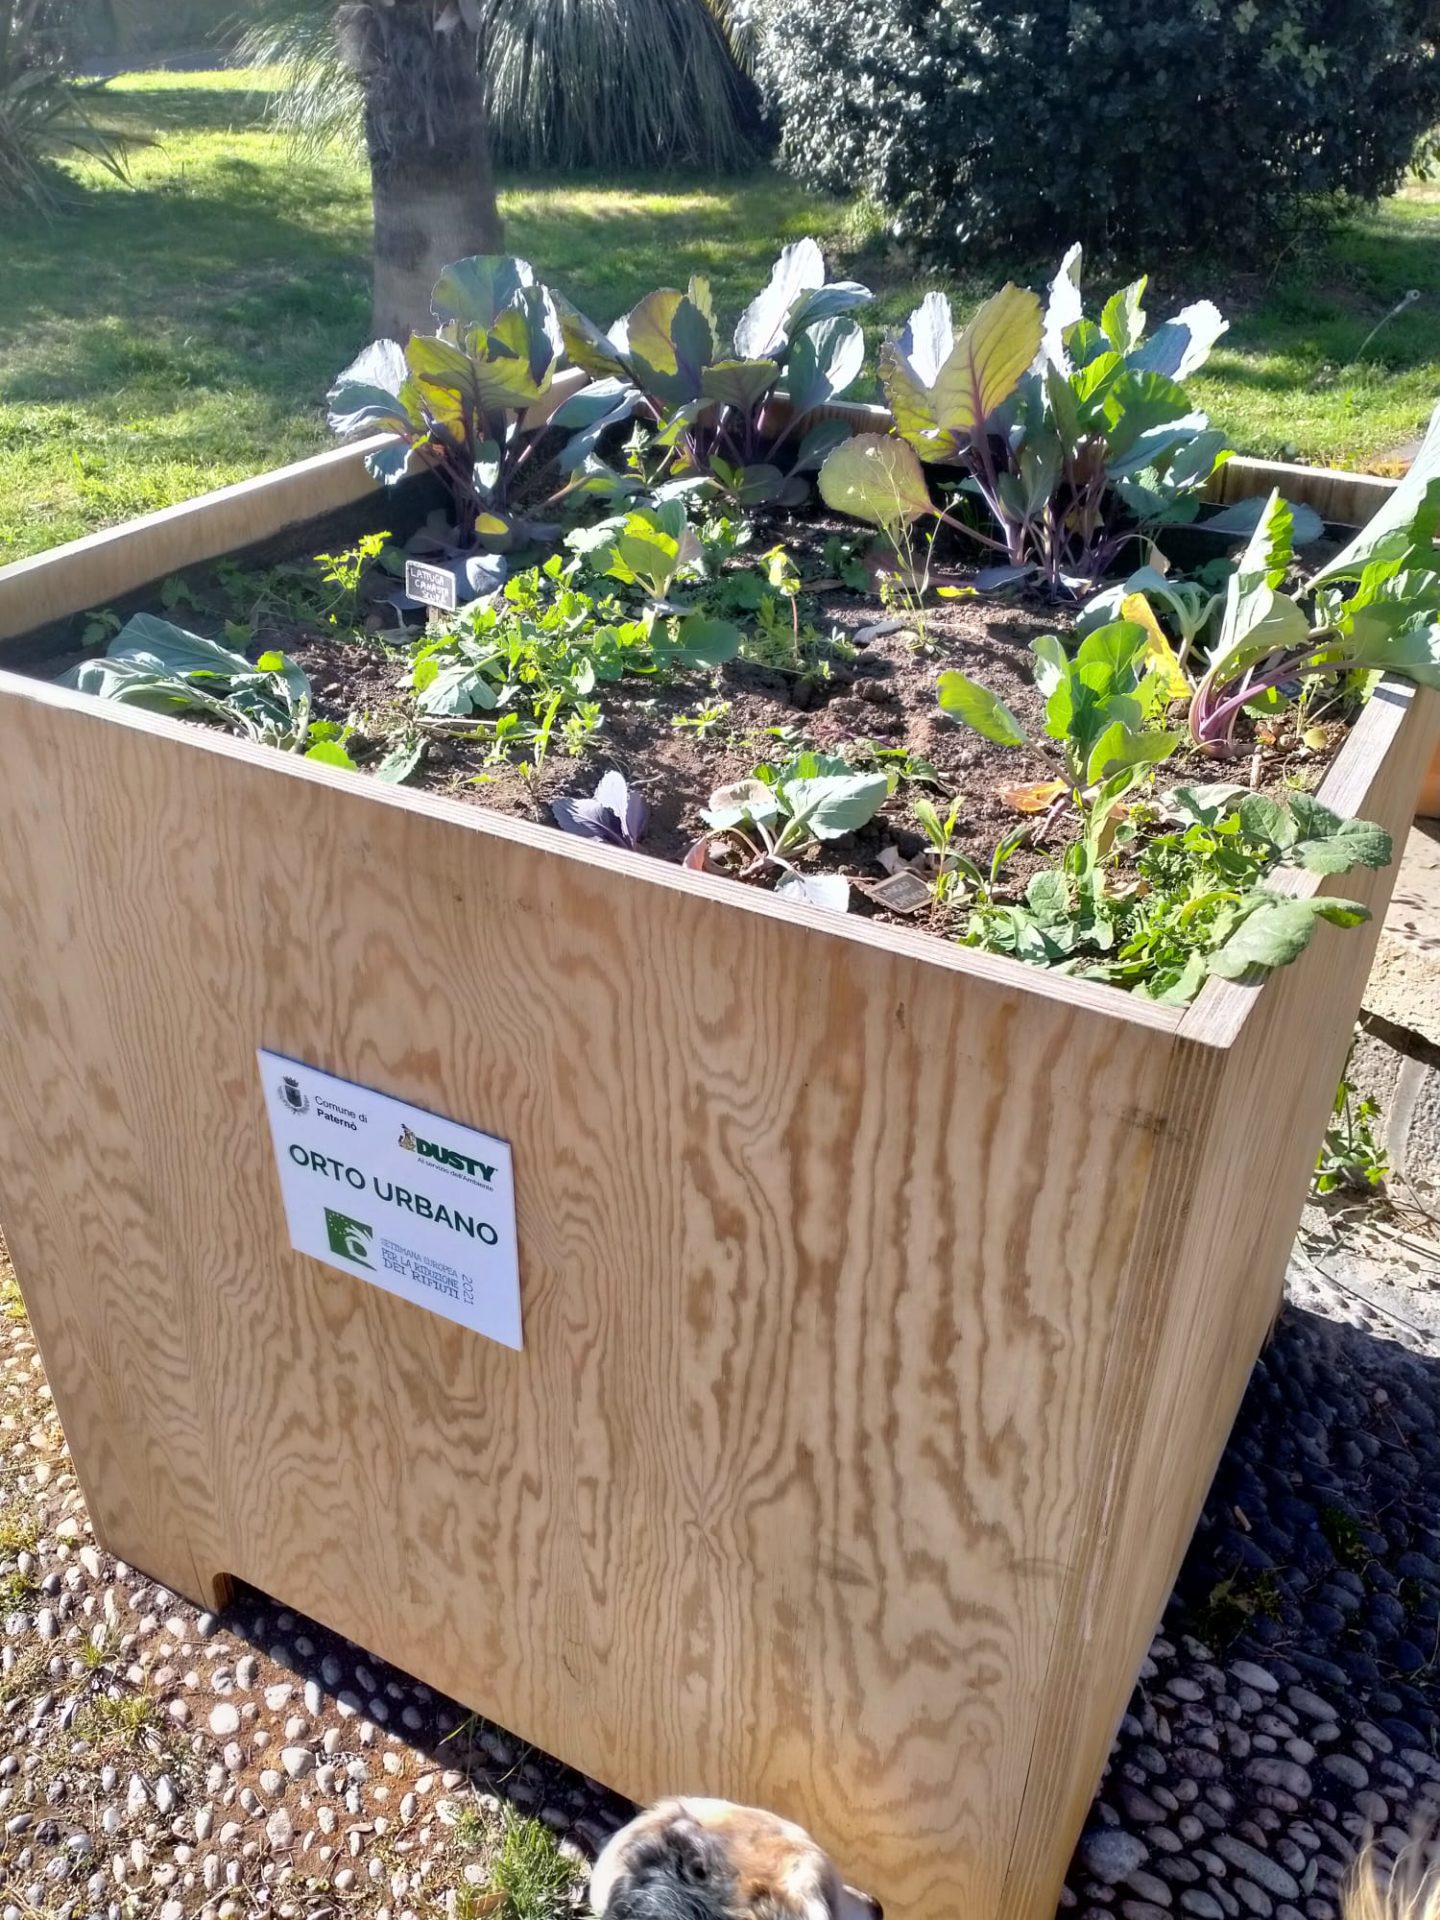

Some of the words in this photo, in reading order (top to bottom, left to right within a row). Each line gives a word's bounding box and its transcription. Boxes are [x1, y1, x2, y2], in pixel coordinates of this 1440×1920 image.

[315, 1095, 356, 1119] Comune
[358, 1112, 368, 1124] di
[316, 1108, 358, 1131] Paternò
[415, 1136, 496, 1182] DUSTY
[289, 1144, 366, 1190] ORTO
[373, 1176, 499, 1245] URBANO
[381, 1238, 422, 1261] SETTIMANA
[423, 1255, 459, 1278] EUROPEA
[381, 1247, 399, 1262] PER
[400, 1256, 412, 1269] LA
[413, 1261, 459, 1289] RIDUZIONE
[383, 1257, 407, 1276] DEI
[411, 1270, 461, 1300] RIFIUTI
[461, 1273, 475, 1305] 2021
